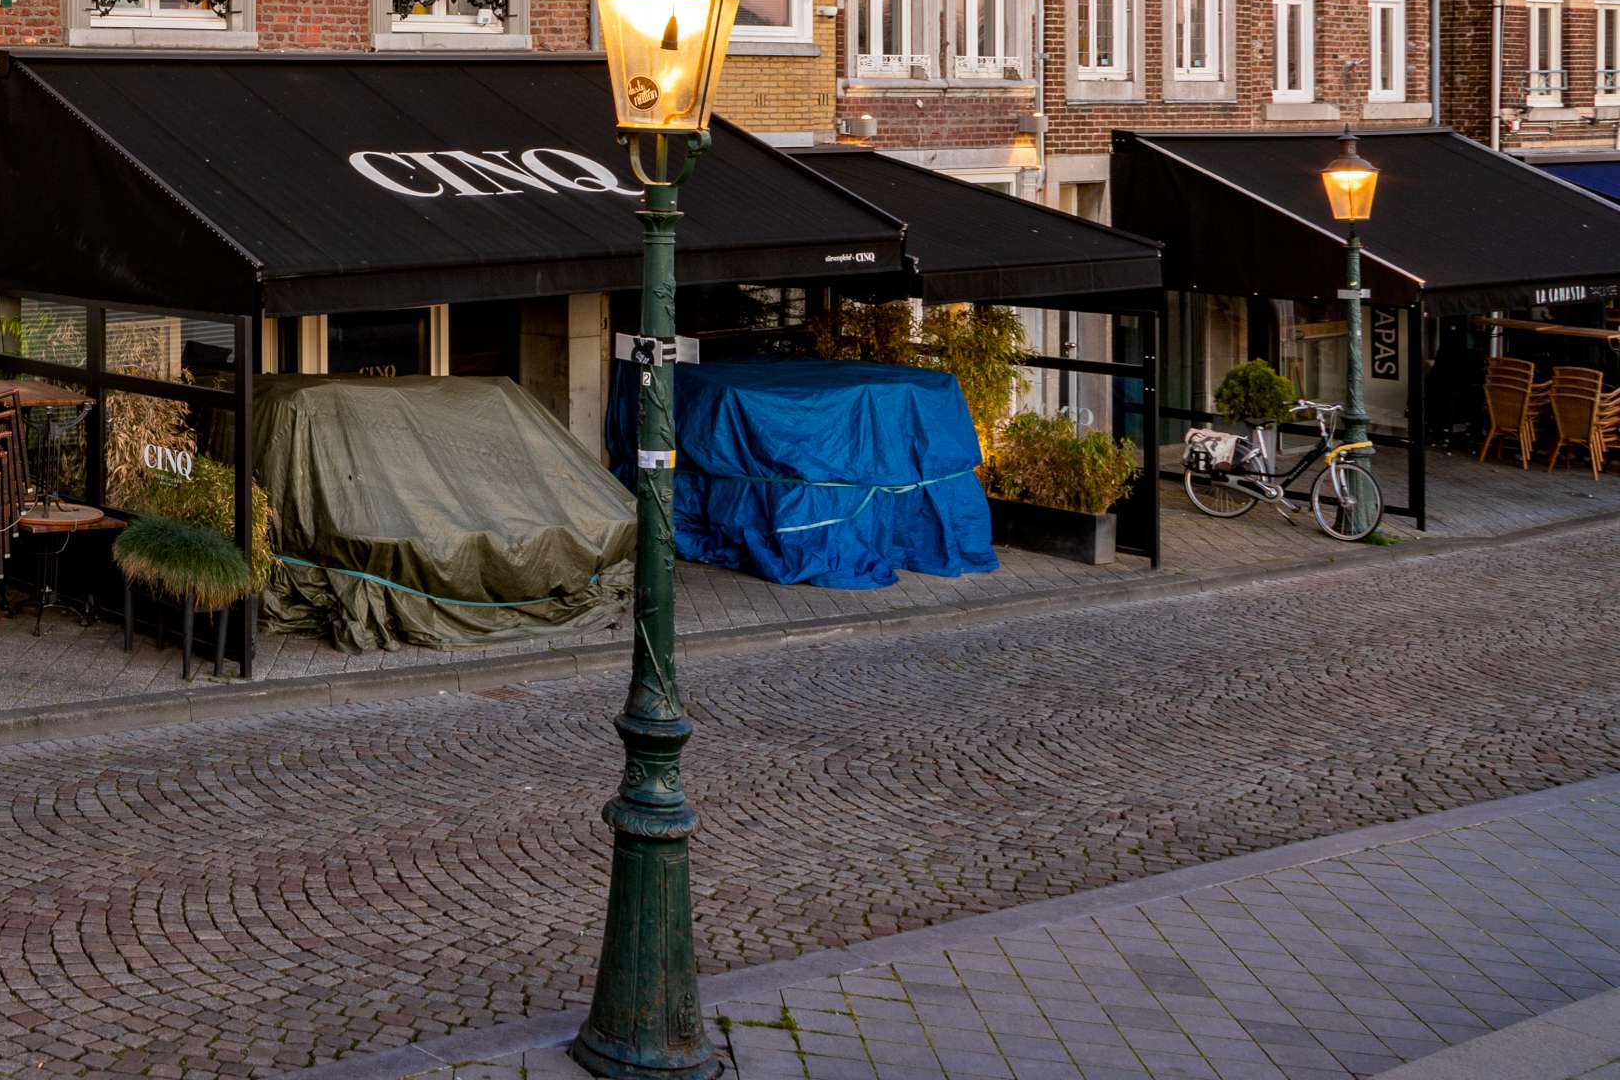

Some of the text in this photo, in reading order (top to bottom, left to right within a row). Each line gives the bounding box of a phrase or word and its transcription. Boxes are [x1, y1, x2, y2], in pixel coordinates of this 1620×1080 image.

[348, 148, 645, 197] CINQ
[855, 252, 875, 262] CINQ
[1374, 307, 1396, 374] APAS
[643, 373, 651, 385] 2
[144, 444, 194, 481] CINQ
